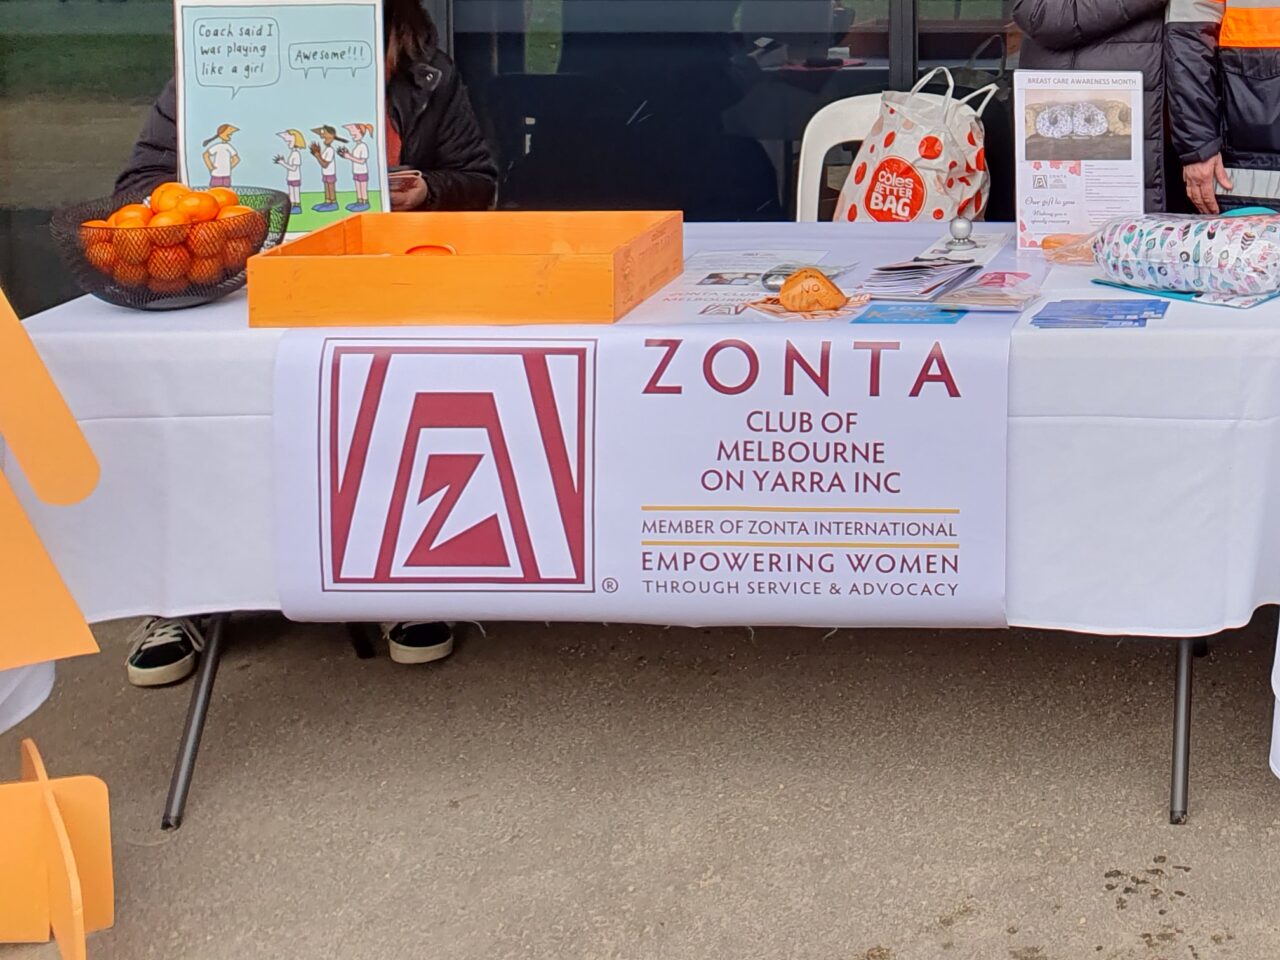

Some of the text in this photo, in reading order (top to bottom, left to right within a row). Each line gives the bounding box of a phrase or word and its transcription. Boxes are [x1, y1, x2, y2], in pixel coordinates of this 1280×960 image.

[199, 23, 275, 37] Coach said I
[200, 42, 267, 59] was playing
[202, 62, 264, 79] like a girl
[875, 182, 913, 200] BETTER
[870, 191, 910, 217] BAG
[642, 338, 962, 398] ZONTA
[746, 410, 858, 434] CLUB OF
[717, 440, 885, 464] MELBOURNE
[701, 469, 901, 494] ON YARRA INC
[641, 520, 958, 537] MEMBER OF ZONTA INTERNATIONAL
[641, 551, 959, 574] EMPOWERING WOMEN
[642, 579, 959, 597] THROUGH SERVICE & ADVOCACY
